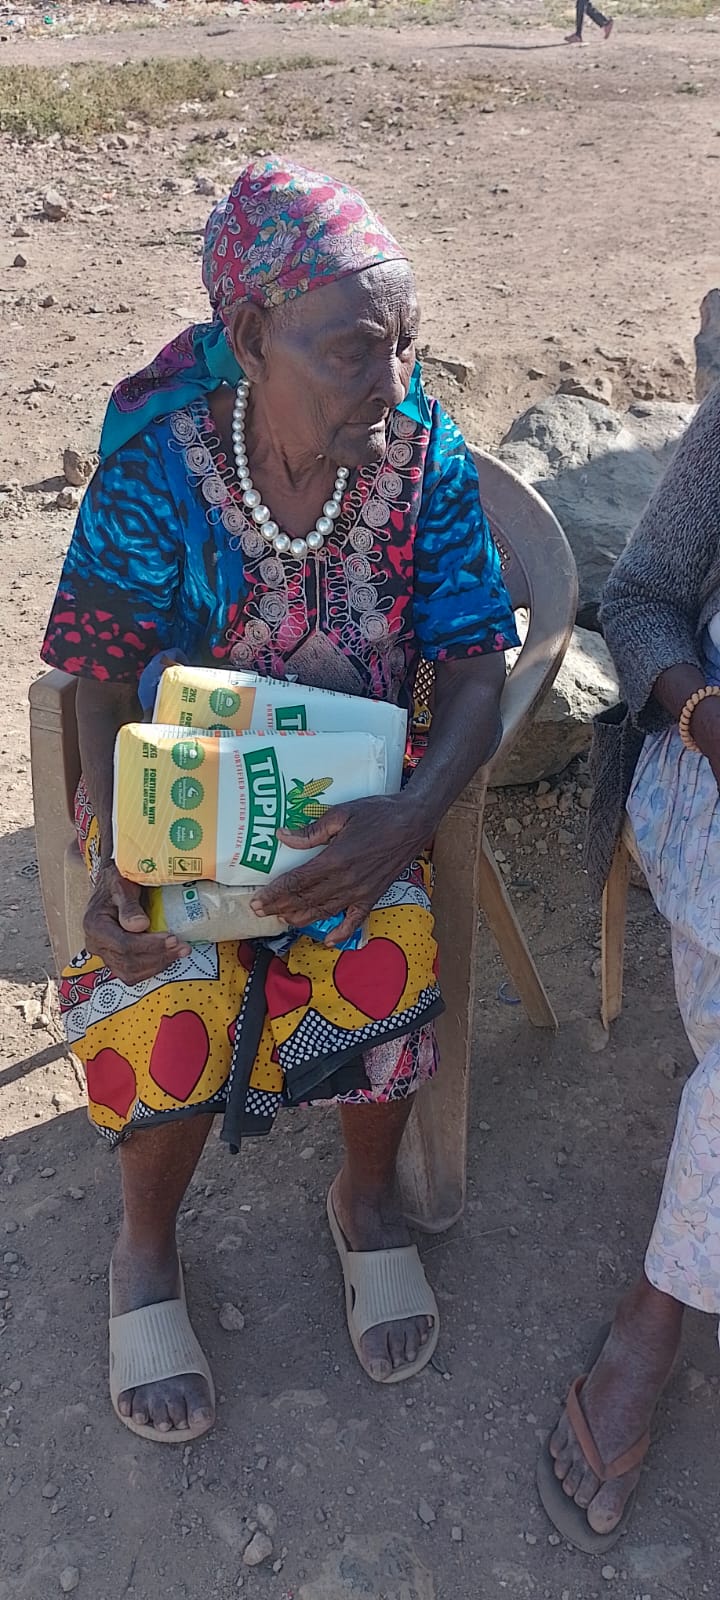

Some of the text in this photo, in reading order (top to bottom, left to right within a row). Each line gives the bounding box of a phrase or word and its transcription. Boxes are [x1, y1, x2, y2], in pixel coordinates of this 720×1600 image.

[181, 687, 189, 703] NETT
[188, 688, 197, 703] 2KG
[233, 750, 245, 790] FORTIFIED
[148, 768, 157, 824] FORTIFIED WITH
[246, 756, 277, 865] TUPIKE
[235, 825, 245, 849] MAIZE
[229, 852, 240, 868] MEAL
